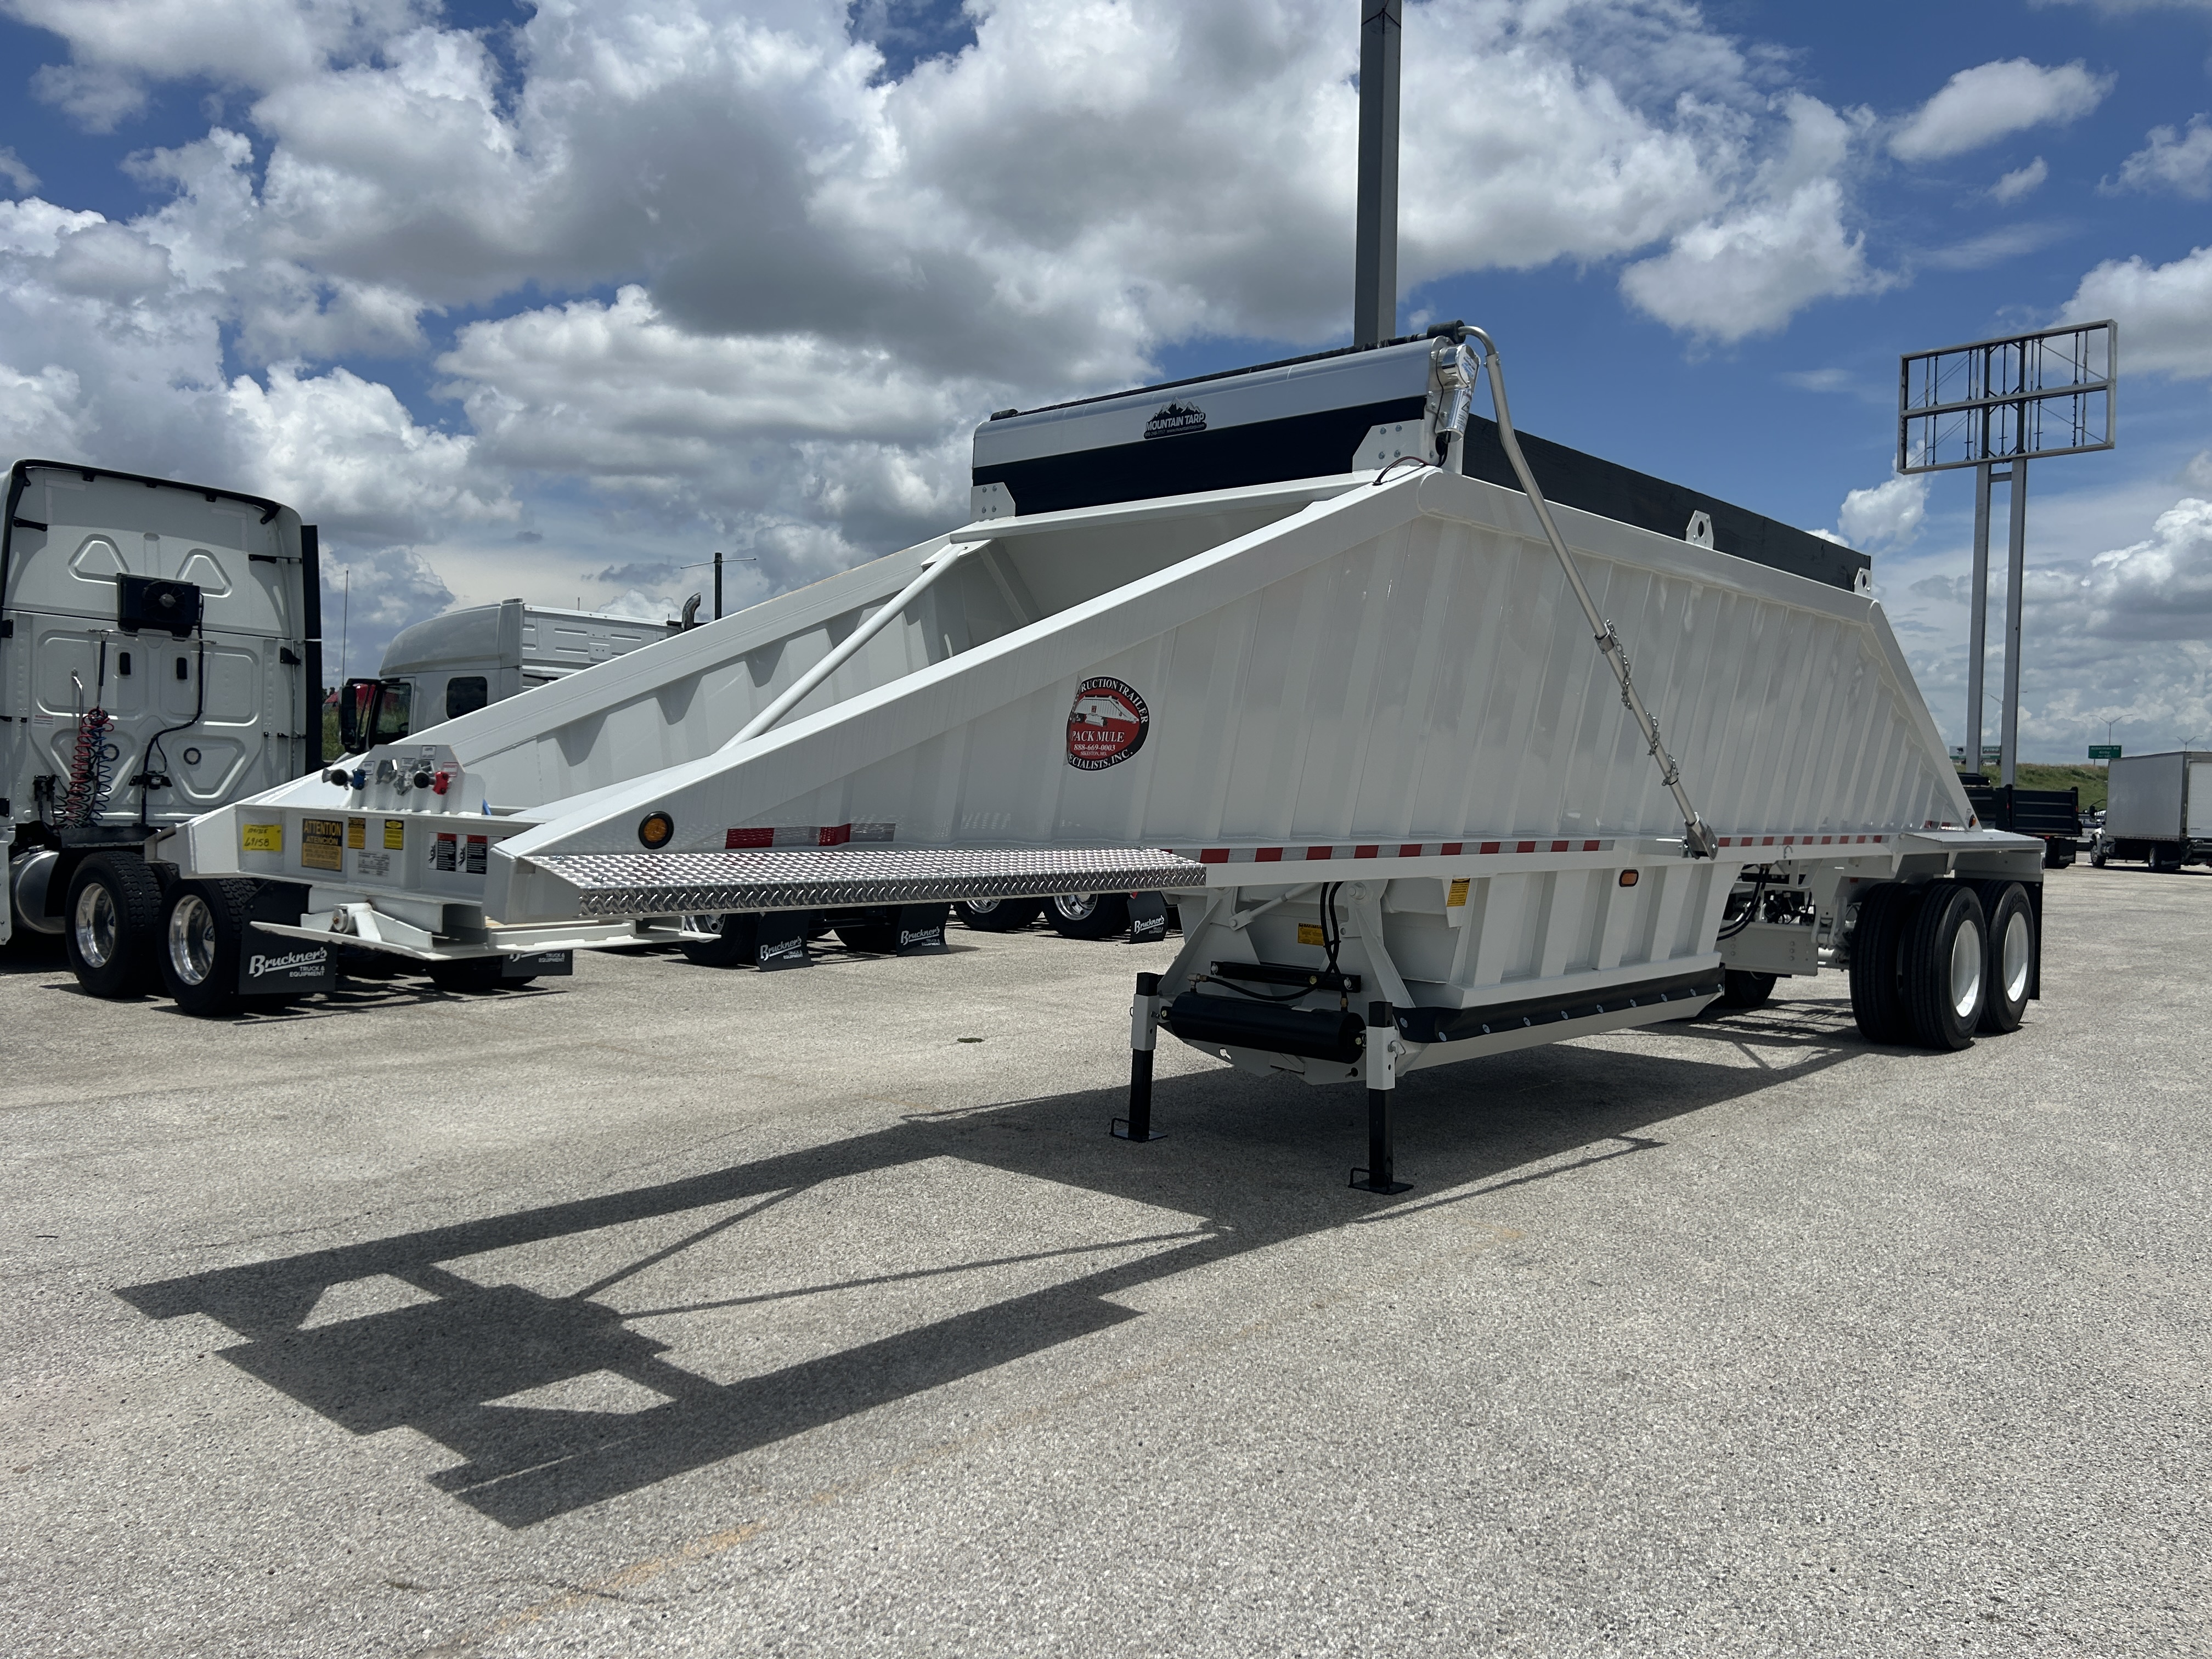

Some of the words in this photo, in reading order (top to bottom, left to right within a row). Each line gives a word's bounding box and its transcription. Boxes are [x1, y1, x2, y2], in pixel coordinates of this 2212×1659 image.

[1145, 415, 1184, 431] MOUNTAIN
[1184, 413, 1205, 425] TARP
[1119, 684, 1149, 724] TRAILER
[1072, 730, 1094, 742] PACK
[1096, 731, 1125, 743] MULE
[1111, 748, 1133, 764] INC.
[303, 820, 342, 836] ATTENTION
[1134, 914, 1165, 934] Bruckner's
[900, 926, 940, 946] Bruckner's
[760, 935, 802, 961] Bruckner's
[248, 946, 328, 978] Bruckner's
